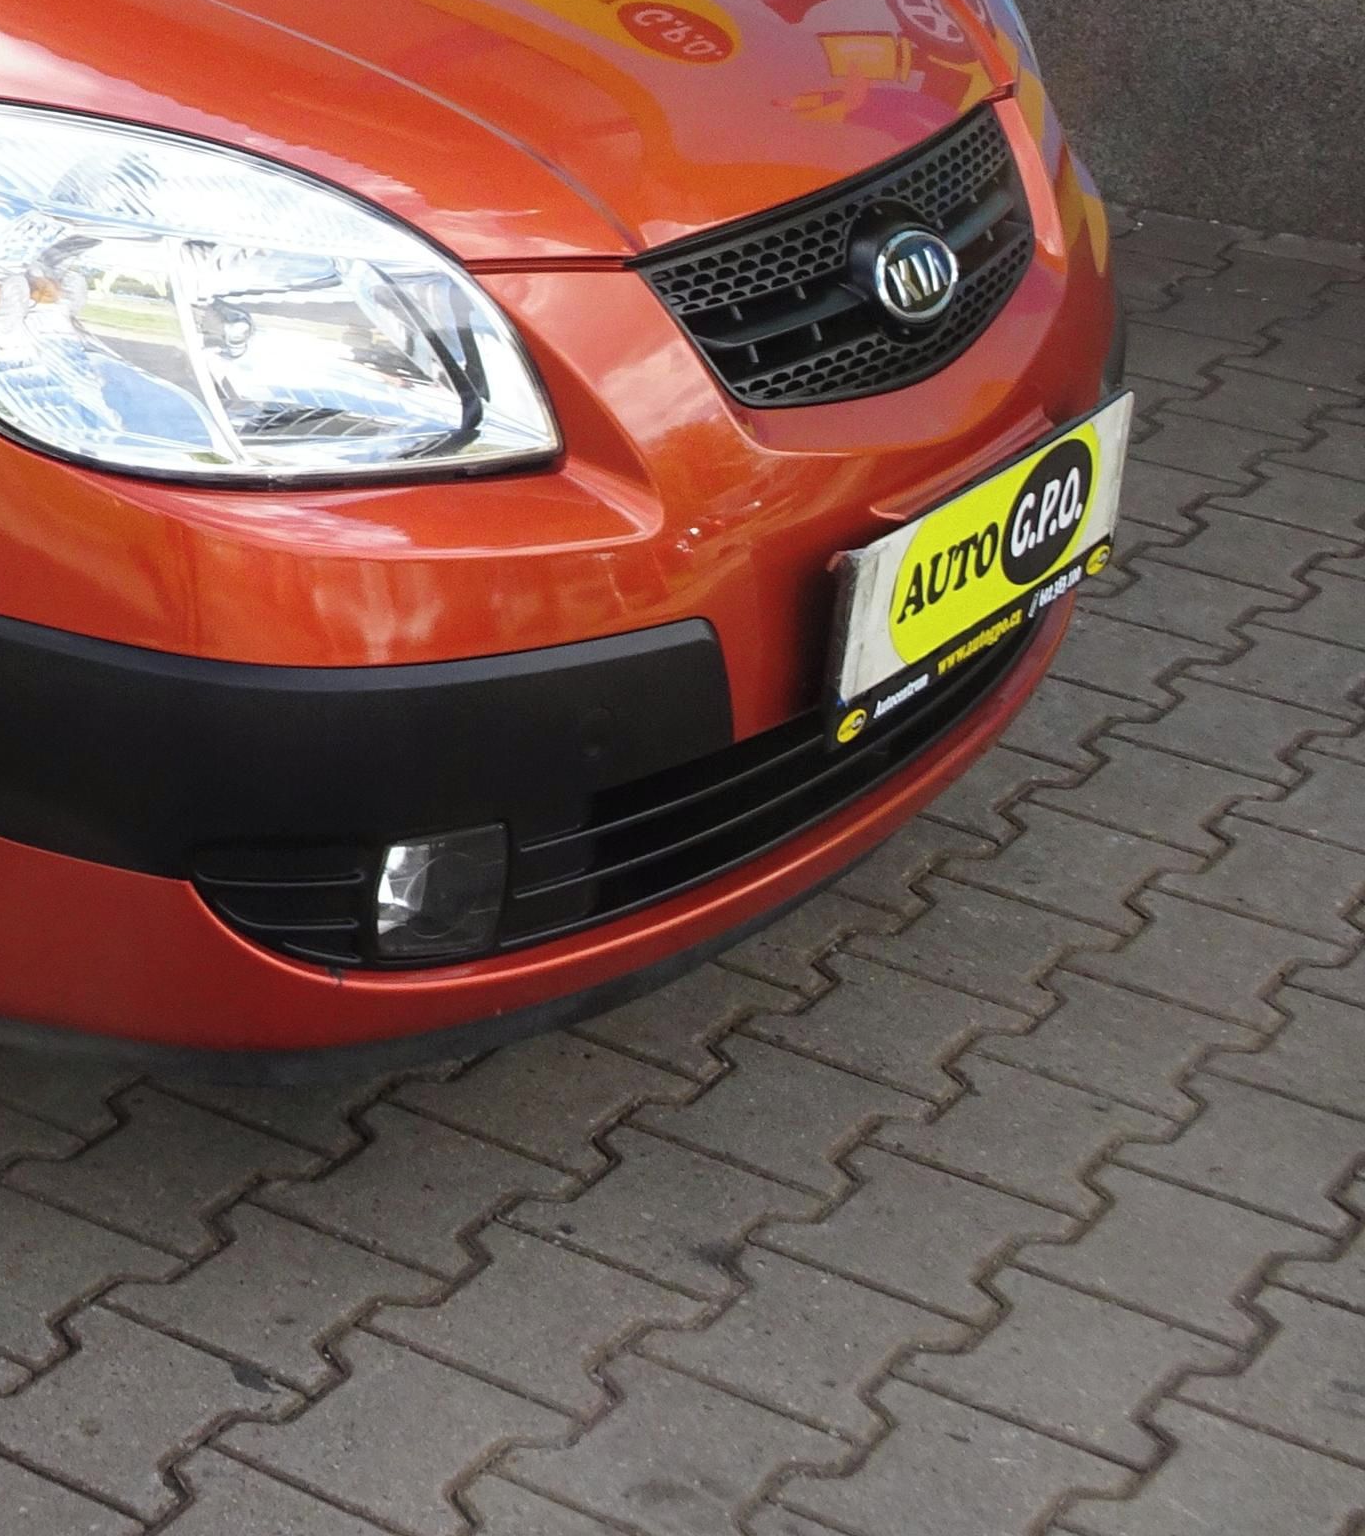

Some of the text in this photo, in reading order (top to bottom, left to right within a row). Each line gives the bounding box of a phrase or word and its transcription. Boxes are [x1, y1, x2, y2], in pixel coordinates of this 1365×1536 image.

[887, 246, 950, 307] KIA
[897, 521, 999, 624] AUTO
[1010, 466, 1082, 558] G.P.O.
